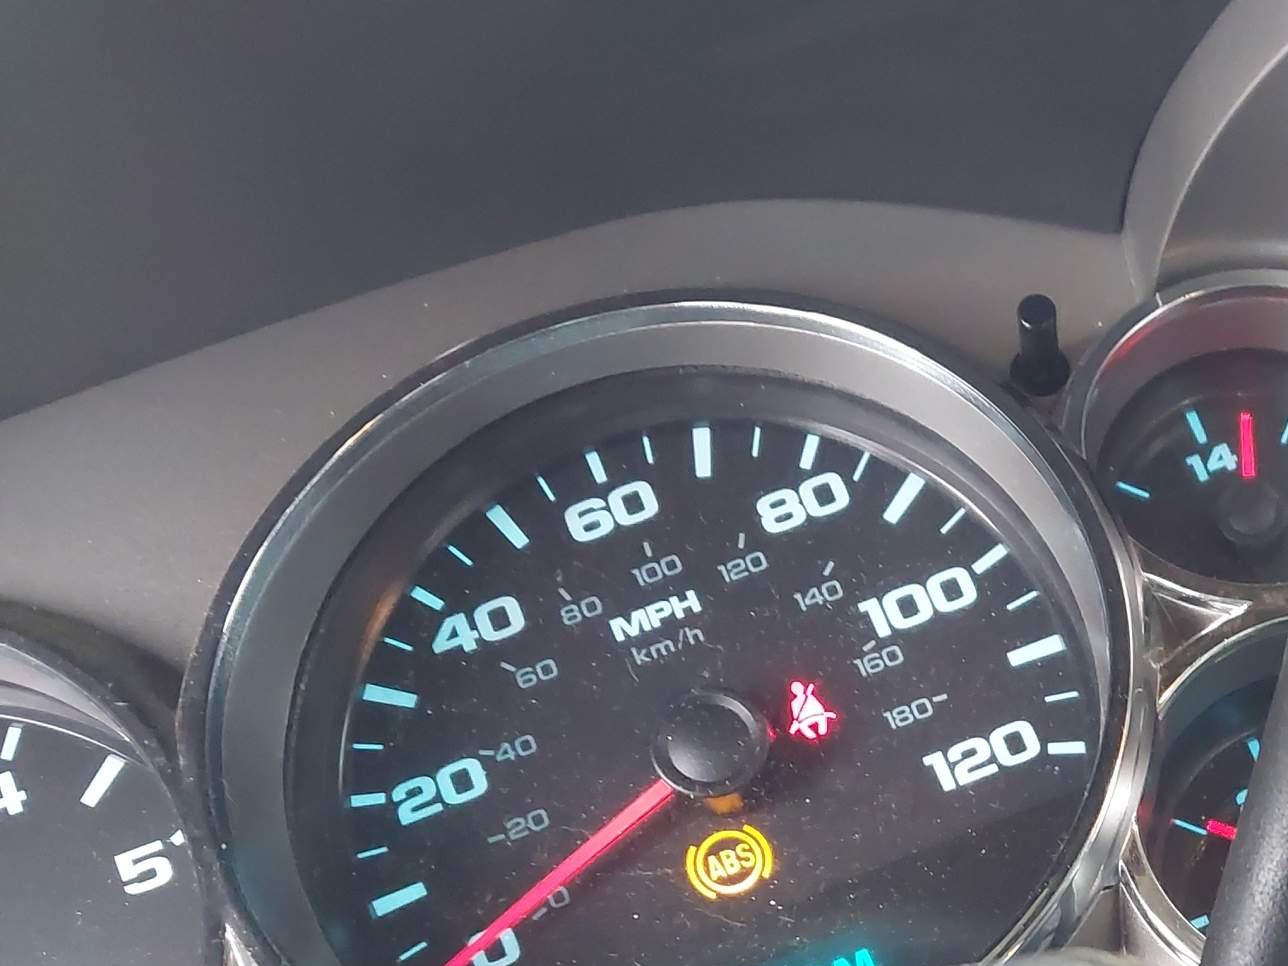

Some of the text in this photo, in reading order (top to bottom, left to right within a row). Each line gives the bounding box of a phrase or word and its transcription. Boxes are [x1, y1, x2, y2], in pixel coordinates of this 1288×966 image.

[1186, 443, 1238, 482] 14
[564, 480, 659, 543] 60
[756, 472, 850, 534] 80
[631, 554, 683, 586] 100
[717, 551, 768, 583] 120
[560, 596, 602, 626] 80
[793, 580, 843, 612] 140
[858, 566, 978, 638] 100
[432, 596, 525, 654] 40
[609, 589, 702, 642] MPH
[631, 626, 705, 666] km/h
[853, 645, 904, 678] 160
[514, 659, 559, 689] 60
[883, 698, 934, 729] 180
[496, 735, 537, 762] 40
[922, 720, 1041, 792] 120
[392, 758, 489, 826] 20
[505, 809, 550, 841] 20
[114, 839, 173, 896] 5
[706, 843, 756, 881] ABS
